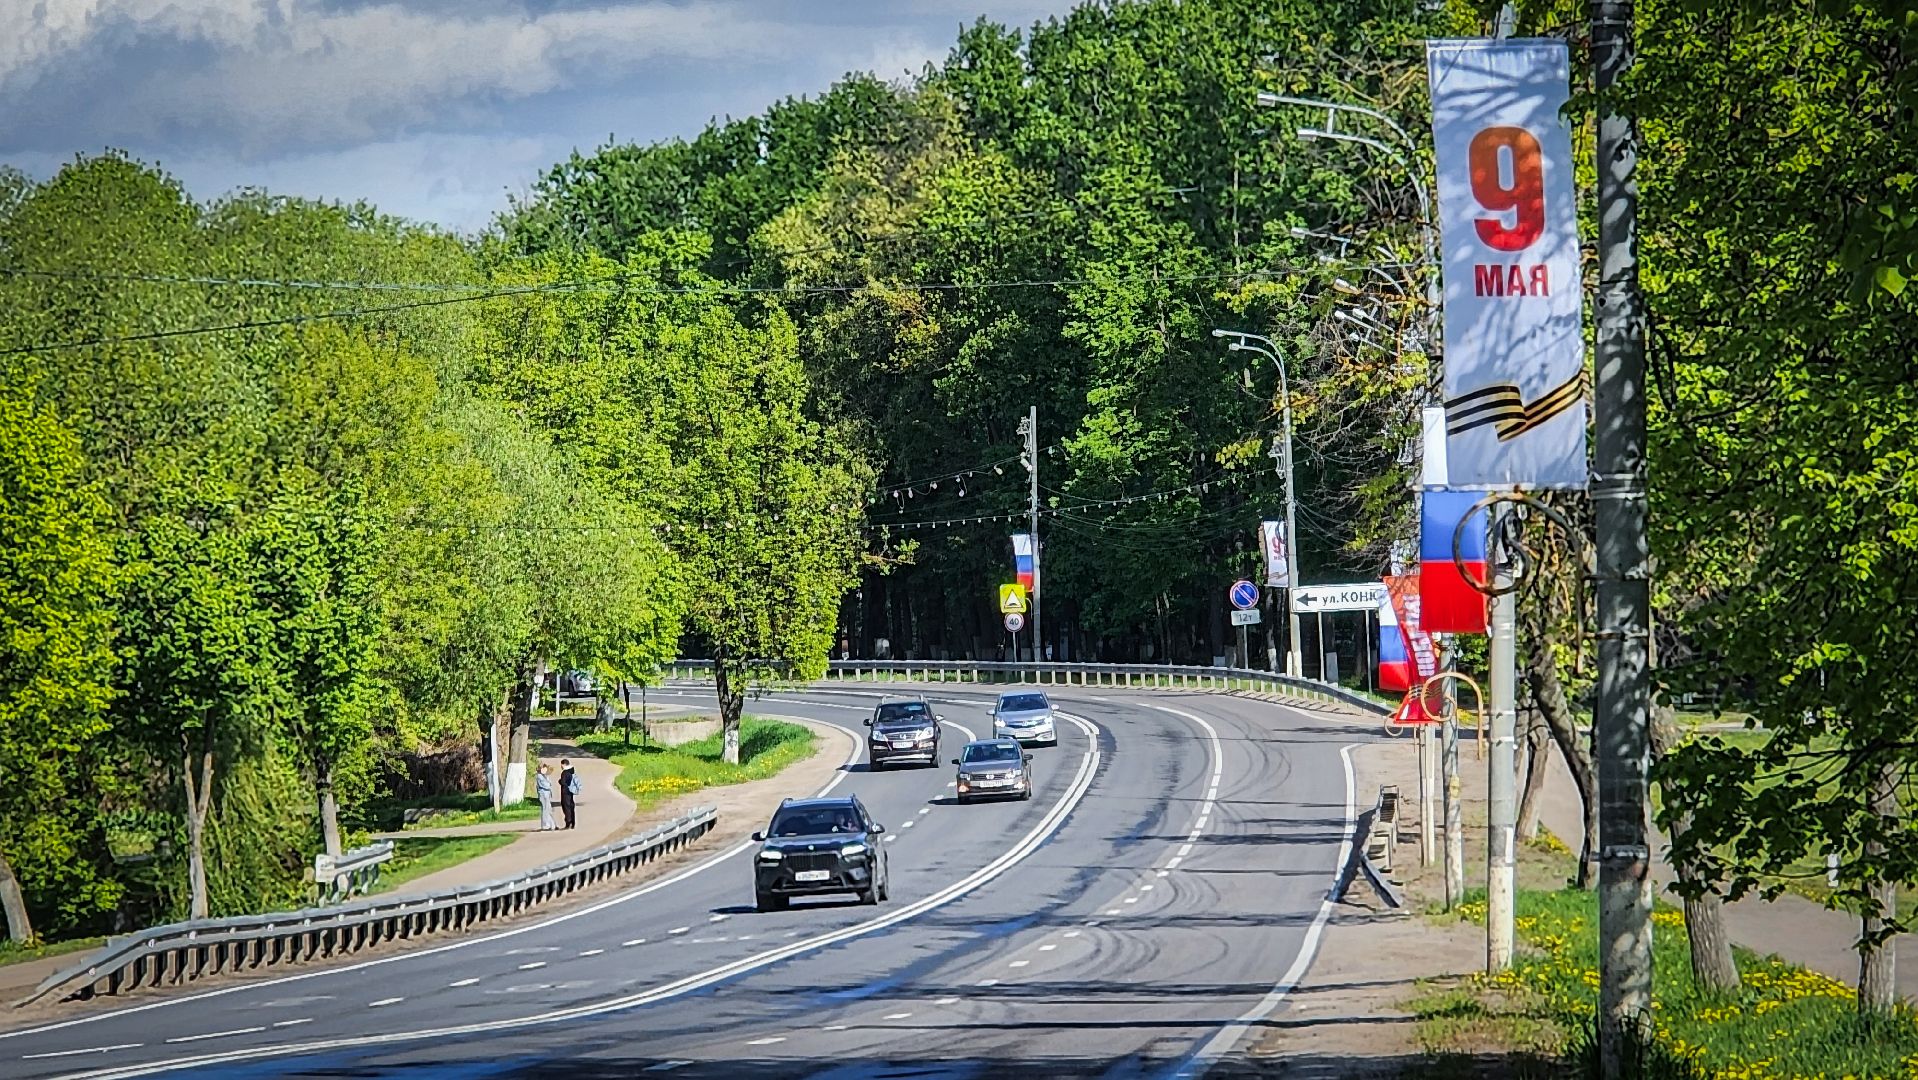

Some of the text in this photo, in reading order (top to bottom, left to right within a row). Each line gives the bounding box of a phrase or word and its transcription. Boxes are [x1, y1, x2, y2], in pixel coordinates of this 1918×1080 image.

[1469, 125, 1545, 252] 9
[1474, 264, 1550, 297] МАЯ
[1009, 617, 1020, 626] 40
